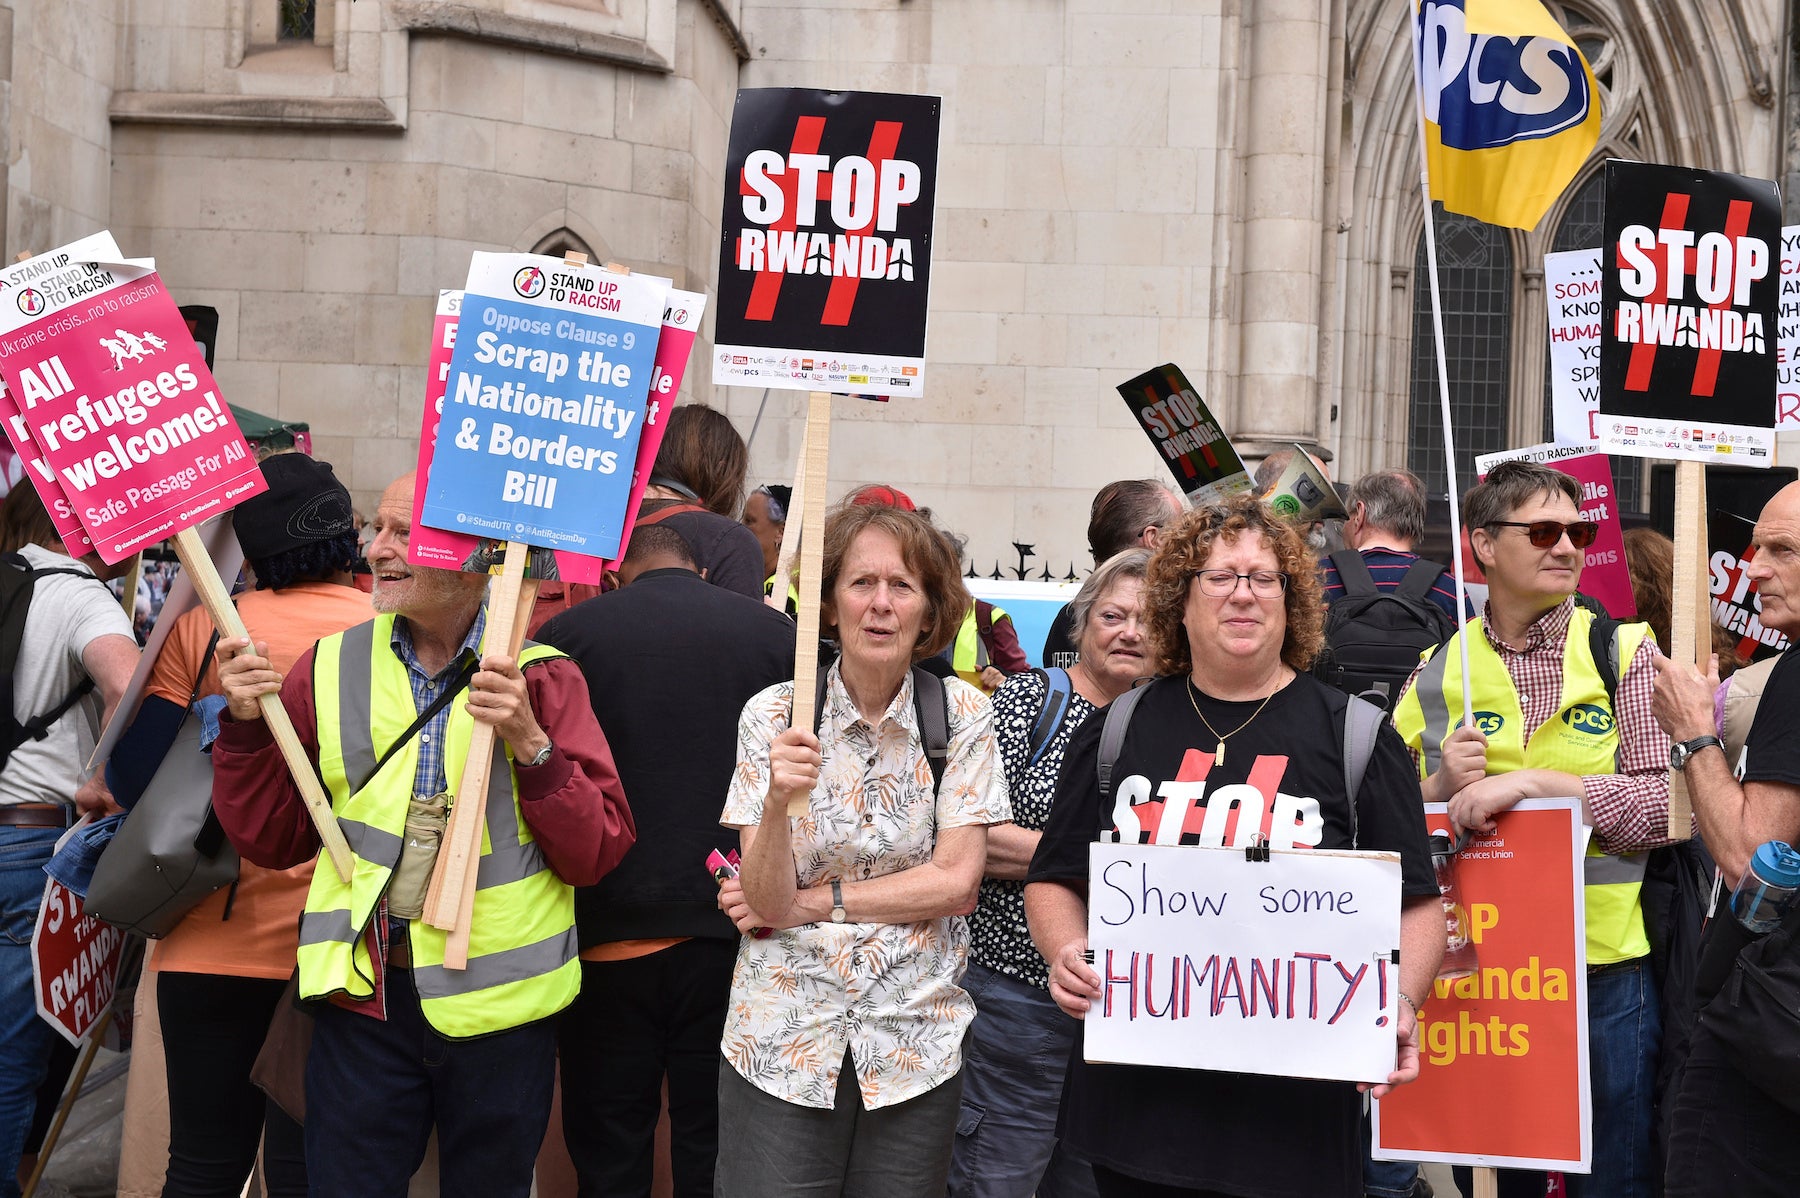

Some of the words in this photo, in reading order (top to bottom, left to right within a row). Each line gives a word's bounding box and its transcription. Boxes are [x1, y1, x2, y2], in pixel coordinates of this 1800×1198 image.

[742, 149, 921, 232] STOP
[10, 260, 52, 285] STAND
[52, 253, 69, 269] UP
[41, 269, 82, 294] STAND
[82, 262, 99, 278] UP
[738, 228, 914, 282] RWANDA
[1617, 225, 1769, 306] STOP
[46, 290, 67, 308] TO
[67, 271, 115, 299] RACISM
[104, 298, 119, 314] to
[118, 282, 160, 308] racism
[550, 273, 594, 292] STAND
[598, 281, 618, 295] UP
[550, 287, 565, 302] TO
[569, 291, 621, 313] RACISM
[482, 307, 551, 335] Oppose
[555, 319, 618, 347] Clause
[623, 332, 635, 350] 9
[1617, 301, 1766, 355] RWANDA
[18, 355, 76, 410] All
[474, 331, 569, 383] Scrap
[578, 351, 631, 388] the
[749, 357, 764, 365] TUC
[40, 362, 199, 452] refugees
[454, 371, 636, 439] Nationality
[1141, 389, 1204, 439] STOP
[61, 391, 229, 492] welcome!
[454, 417, 481, 452] &
[488, 423, 618, 475] Borders
[1161, 421, 1222, 460] RWANDA
[1533, 451, 1545, 463] TO
[1547, 446, 1585, 460] RACISM
[85, 498, 129, 528] Safe
[126, 465, 198, 508] Passage
[196, 452, 222, 478] For
[224, 439, 246, 462] All
[502, 470, 557, 509] Bill
[466, 516, 511, 531] @StandUTR
[525, 527, 587, 545] @AntiRacismDay
[1568, 708, 1610, 731] pcs
[1101, 774, 1325, 849] STOP
[1460, 850, 1490, 859] Services
[1491, 850, 1514, 859] Union
[1100, 860, 1227, 926] Show
[1259, 885, 1359, 915] some
[74, 915, 97, 943] THE
[50, 926, 120, 1016] RWANDA
[1104, 949, 1390, 1028] HUMANITY!
[74, 967, 113, 1035] PLAN
